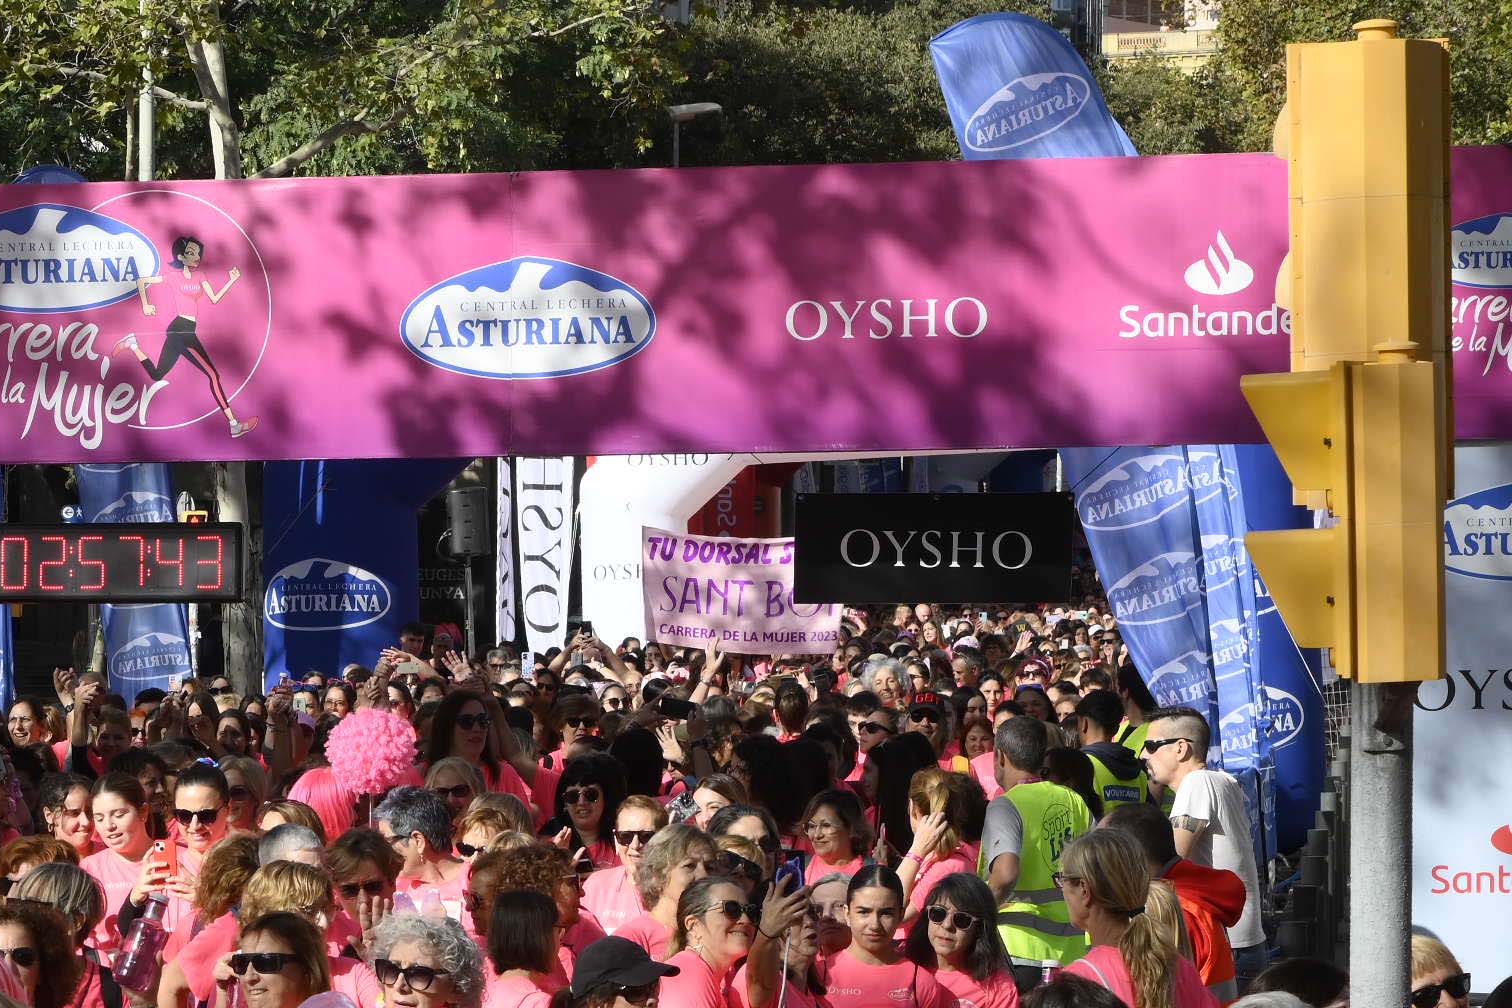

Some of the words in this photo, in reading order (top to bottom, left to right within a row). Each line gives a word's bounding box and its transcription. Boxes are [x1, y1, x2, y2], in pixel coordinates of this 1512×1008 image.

[62, 240, 136, 251] LECHERA
[460, 300, 538, 313] CENTRAL
[547, 298, 627, 311] LECHERA
[785, 296, 988, 342] OYSHO
[1118, 305, 1294, 338] Santande
[420, 304, 636, 348] ASTURIANA
[1469, 324, 1488, 352] la
[1, 364, 26, 404] la
[21, 355, 171, 450] Mujer
[0, 535, 223, 590] 02:57:43
[648, 537, 677, 562] TU
[682, 539, 772, 566] DORSAL
[839, 528, 1034, 571] OYSHO
[268, 588, 382, 616] ASTURIANA
[659, 575, 754, 617] SANT
[659, 623, 717, 639] CARRERA
[722, 630, 739, 642] DE
[743, 631, 759, 643] LA
[762, 631, 807, 643] MUJER
[810, 630, 838, 642] 2023
